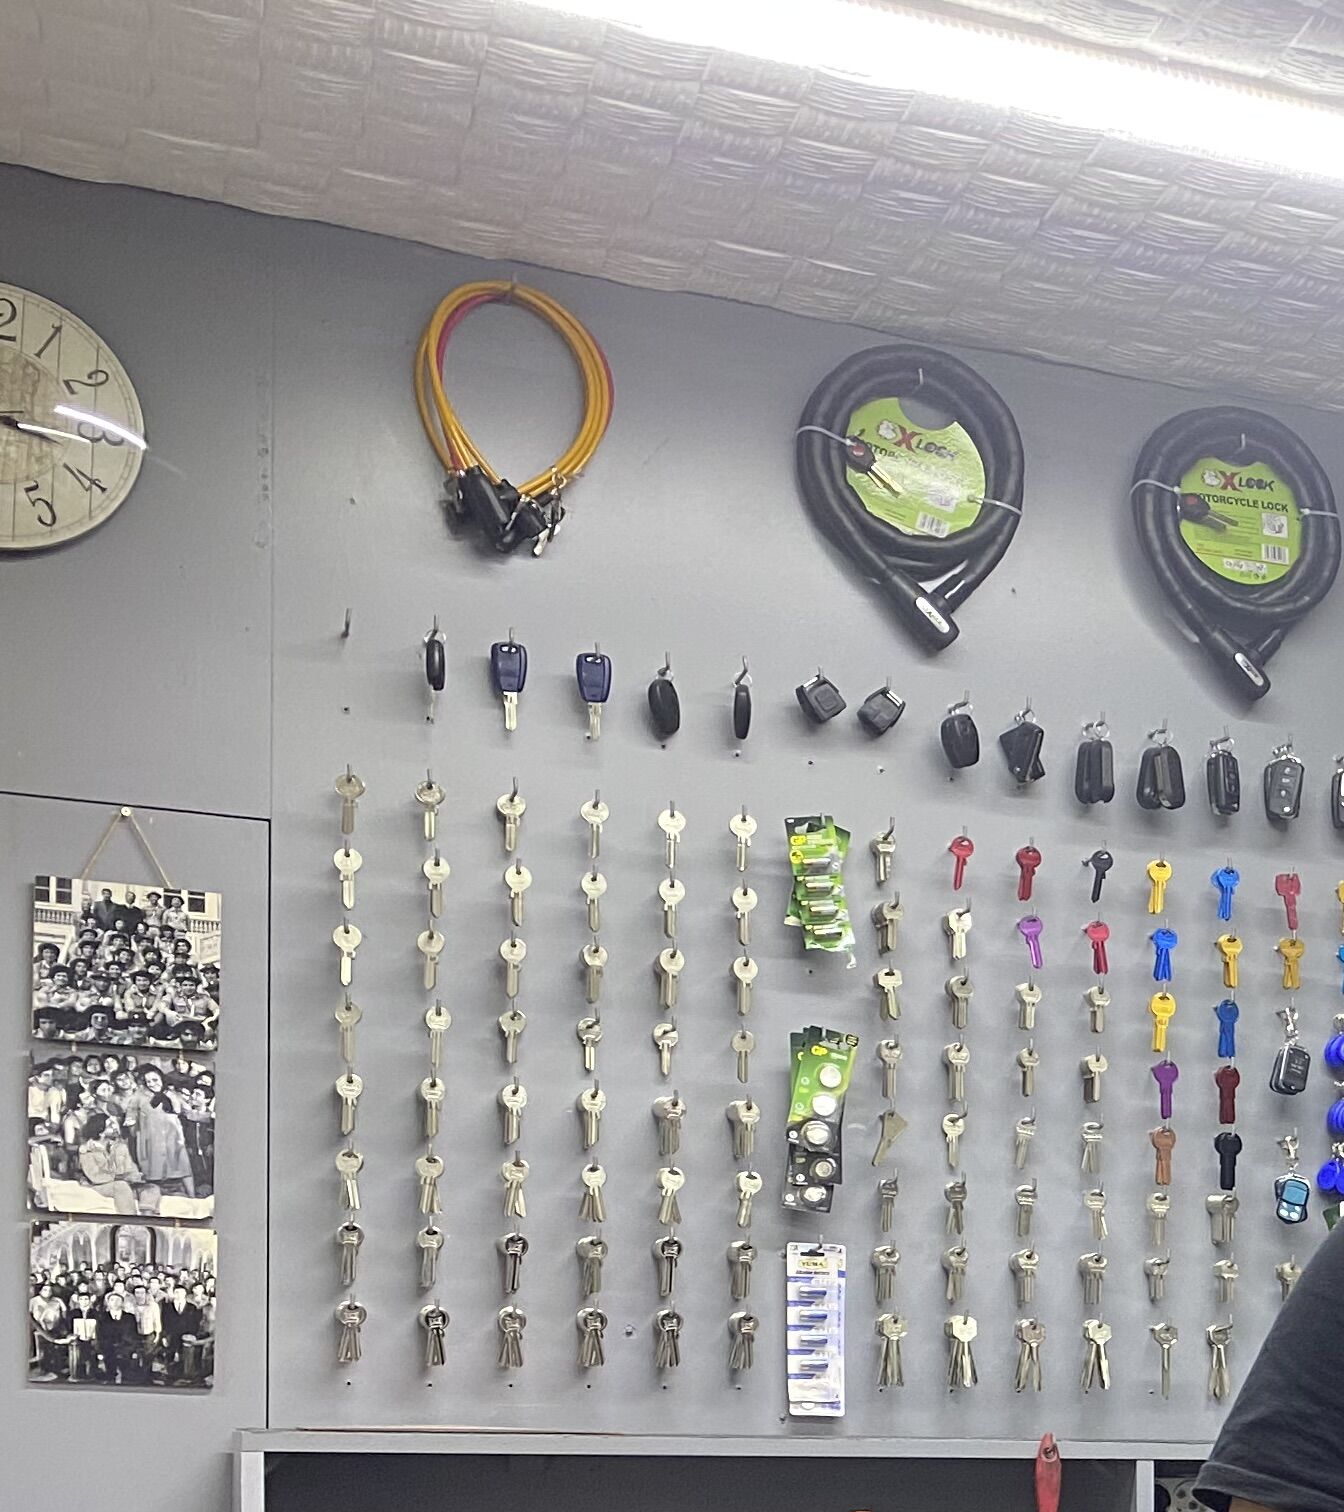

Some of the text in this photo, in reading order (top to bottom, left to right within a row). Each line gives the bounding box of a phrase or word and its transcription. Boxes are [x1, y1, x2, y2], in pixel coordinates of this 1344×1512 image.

[0, 298, 17, 342] 2
[35, 322, 63, 359] 1
[63, 368, 109, 396] 2
[63, 462, 108, 493] 4
[23, 479, 57, 528] 5
[1200, 493, 1289, 513] OTORCYCLE LOCK
